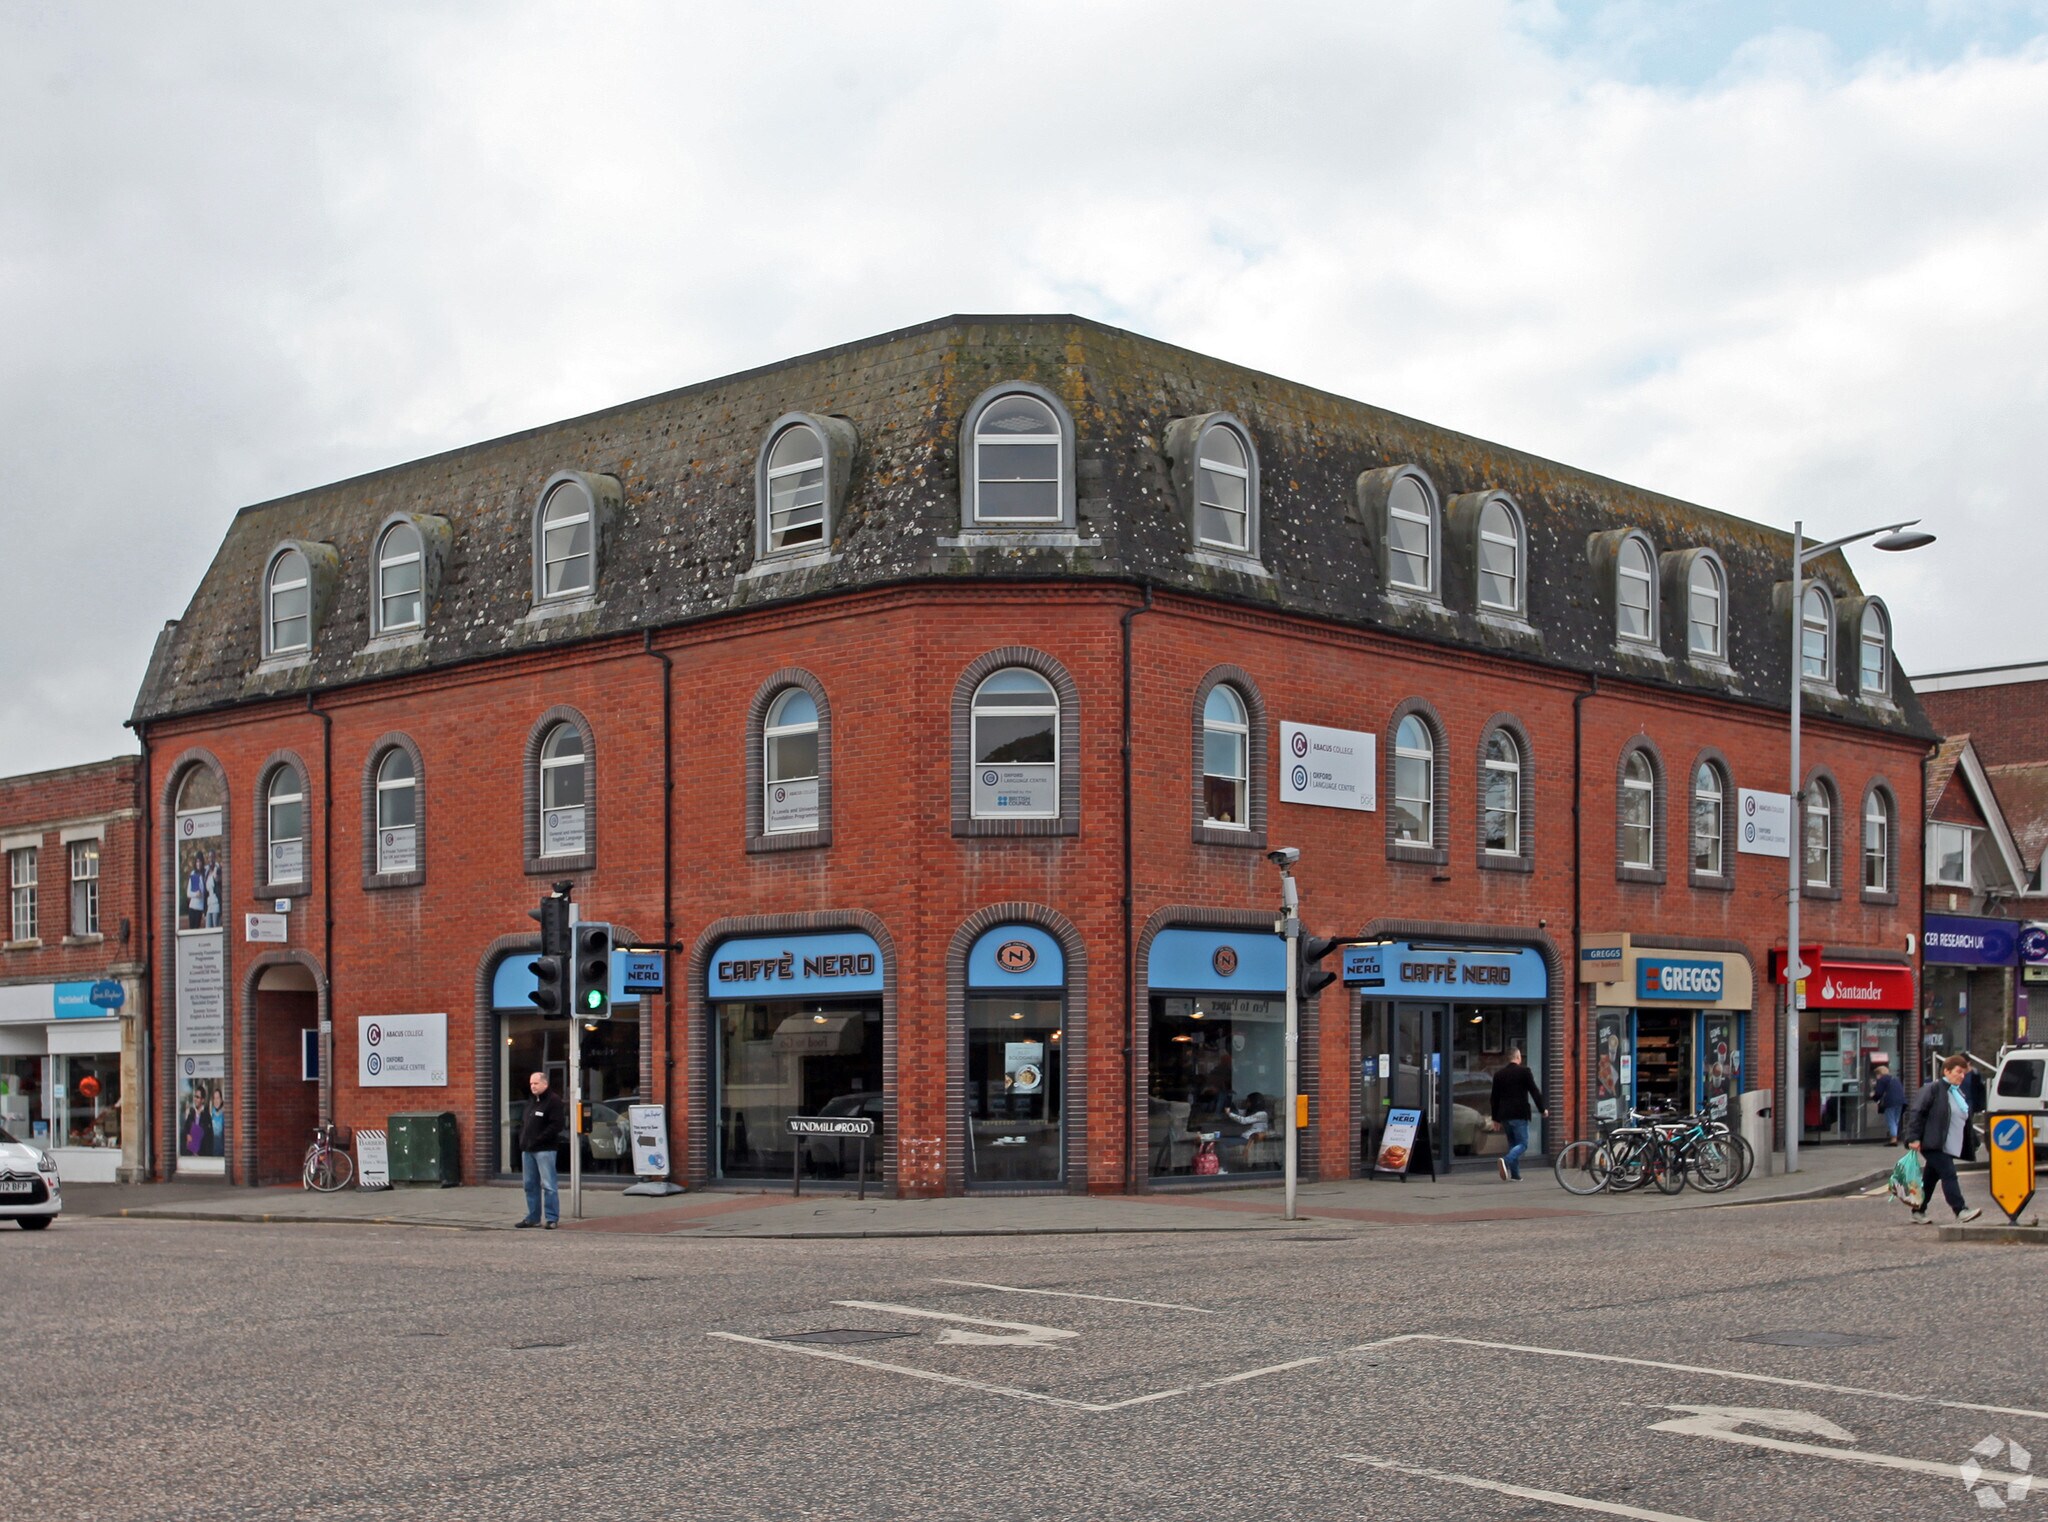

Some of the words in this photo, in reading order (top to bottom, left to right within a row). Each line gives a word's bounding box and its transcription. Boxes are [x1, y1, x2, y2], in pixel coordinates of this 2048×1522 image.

[1312, 743, 1332, 752] ABACUS
[1333, 745, 1354, 755] COLLEGE
[1312, 772, 1332, 780] OXFORD
[1312, 781, 1338, 791] LANGUAGE
[1338, 784, 1356, 792] CENTRE
[1940, 933, 1974, 948] RESEARCH
[1975, 936, 1984, 949] UK
[1009, 950, 1023, 962] N
[1590, 949, 1620, 958] GREGGS
[1222, 955, 1231, 966] N
[718, 951, 794, 982] CAFFÈ
[803, 953, 874, 978] NERO
[1347, 965, 1380, 974] NERO
[1400, 957, 1457, 984] CAFFÈ
[1462, 964, 1511, 985] NERO
[628, 971, 660, 980] NERO
[1661, 966, 1721, 992] GREGGS
[1836, 980, 1882, 1000] Santander
[386, 1063, 408, 1071] LANGUAGE
[410, 1063, 426, 1071] CENTRE
[790, 1121, 835, 1132] WINDMILL
[841, 1123, 869, 1134] ROAD
[12, 1182, 28, 1191] BFP
